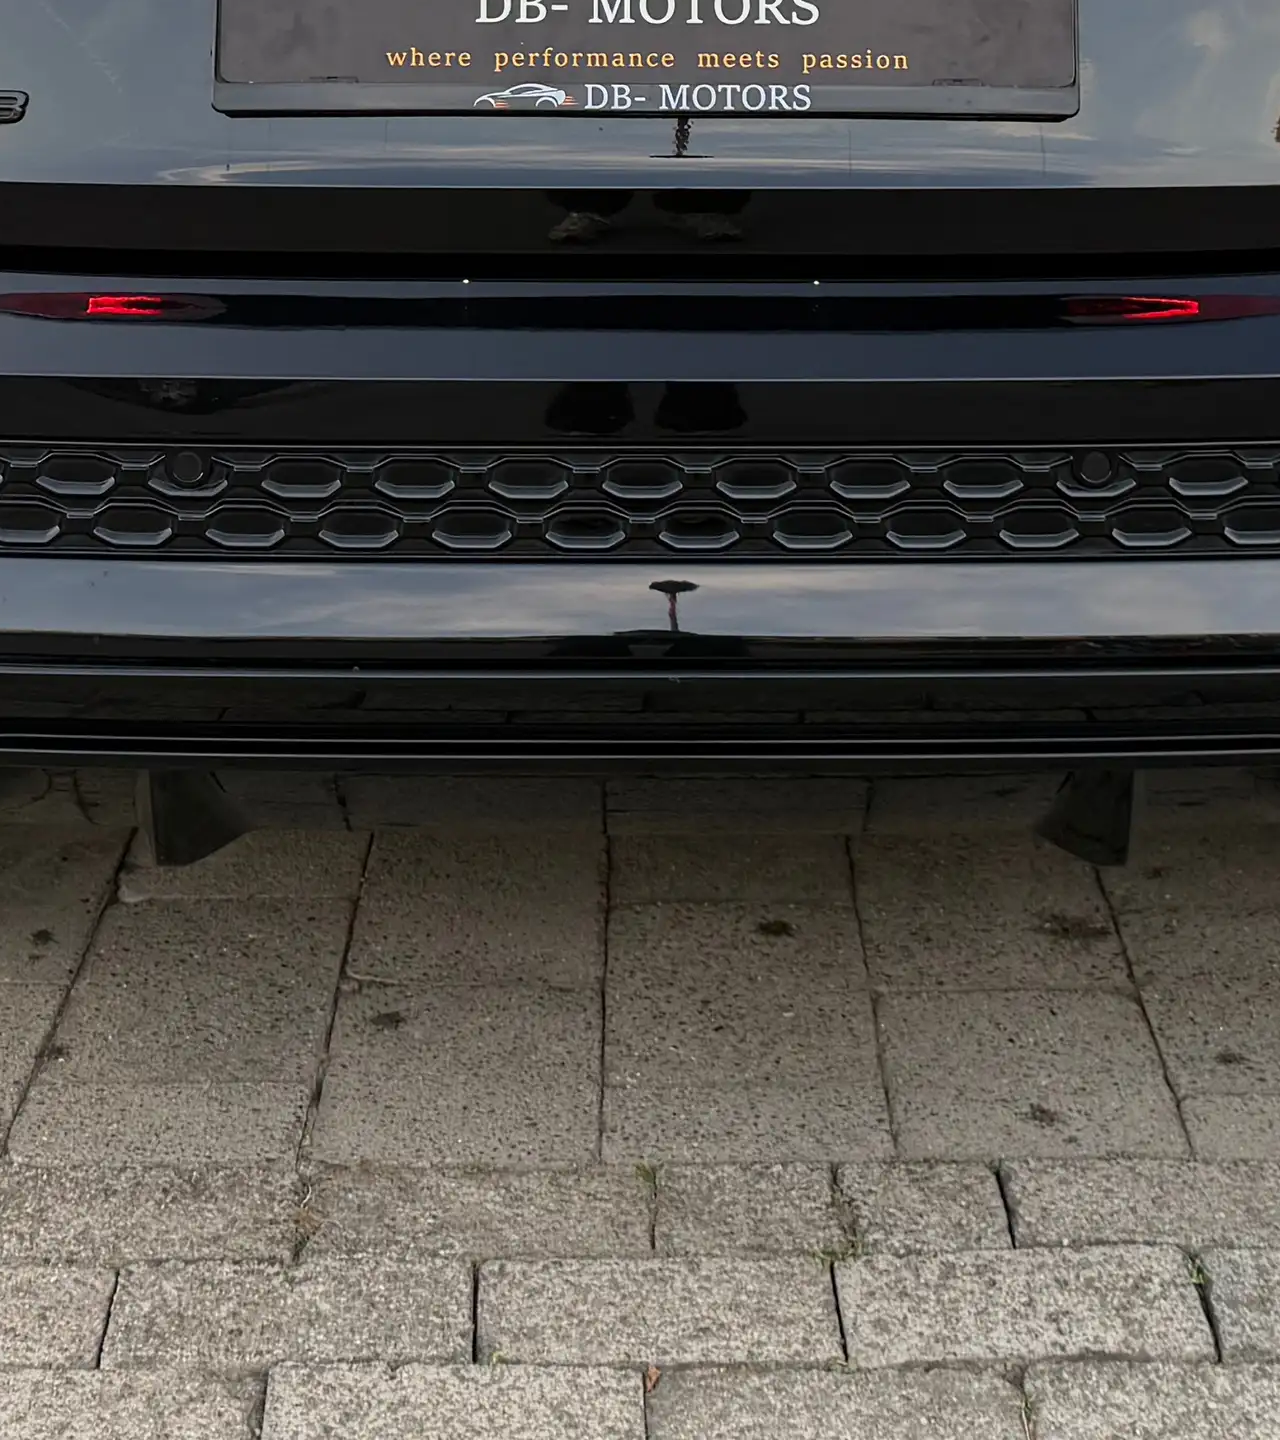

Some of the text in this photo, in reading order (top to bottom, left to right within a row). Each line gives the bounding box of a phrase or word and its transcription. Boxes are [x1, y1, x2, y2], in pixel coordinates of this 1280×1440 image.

[386, 47, 908, 74] where performance meets passion
[584, 83, 812, 111] DB- MOTORS
